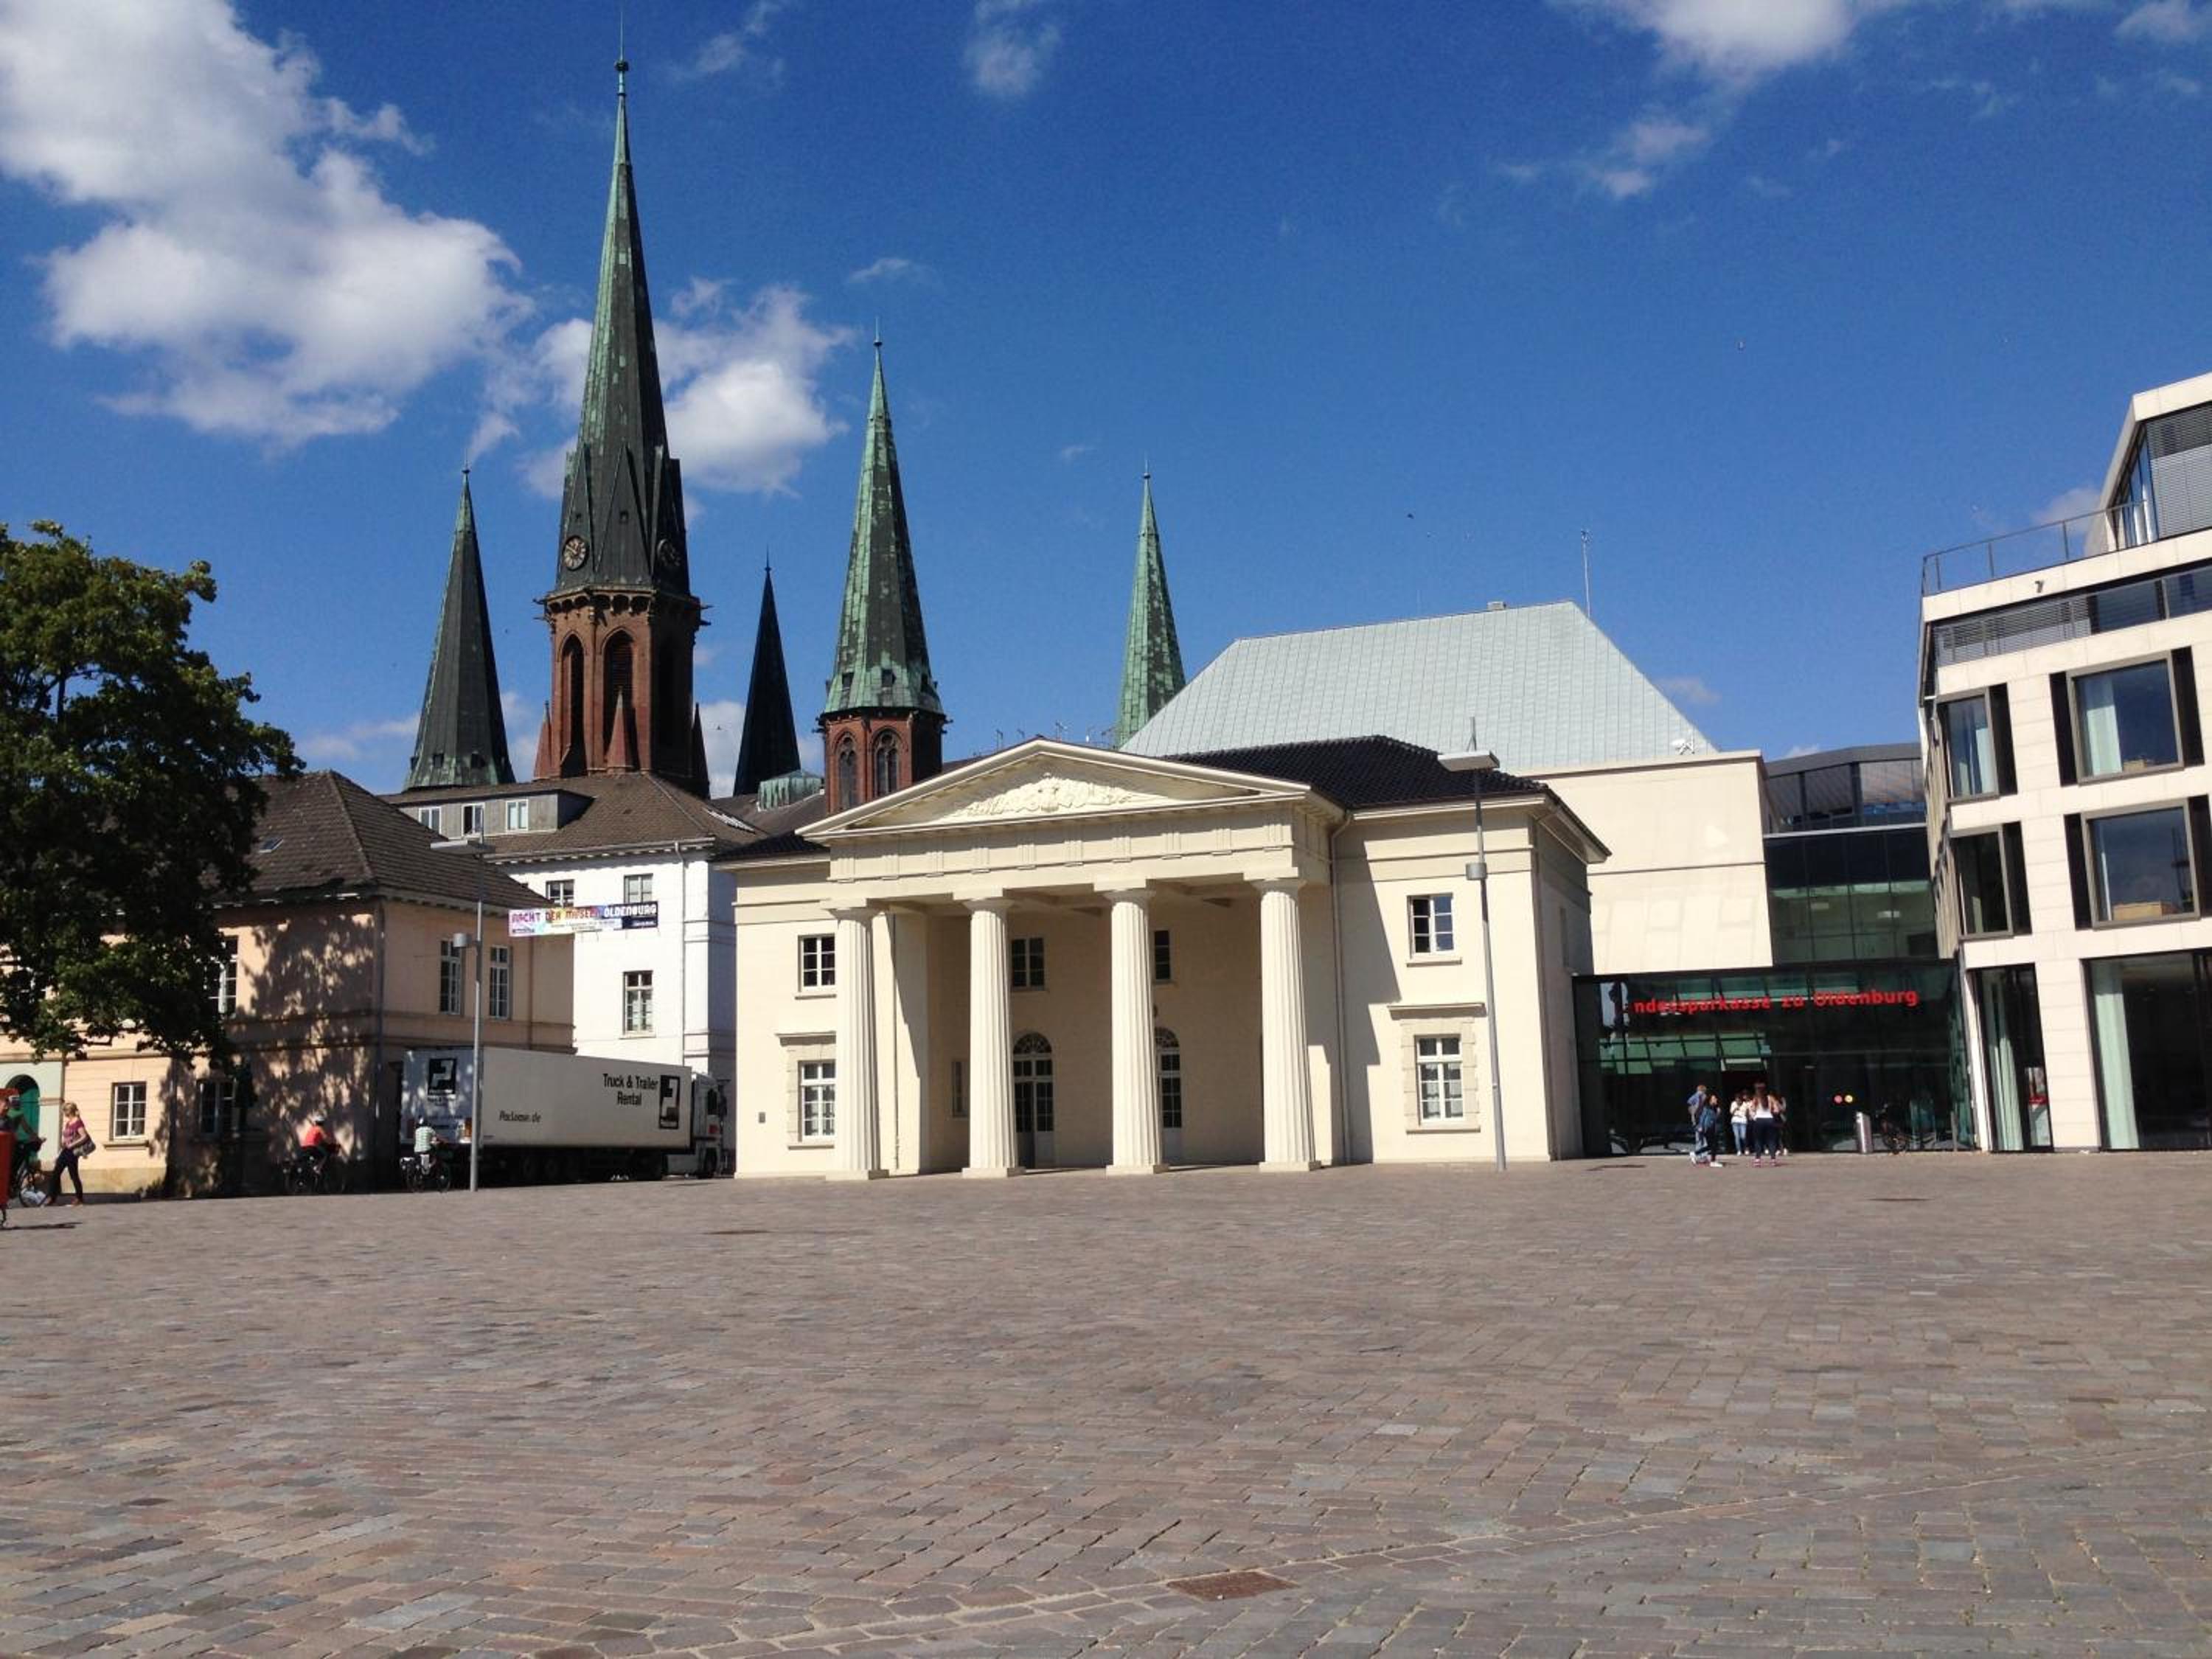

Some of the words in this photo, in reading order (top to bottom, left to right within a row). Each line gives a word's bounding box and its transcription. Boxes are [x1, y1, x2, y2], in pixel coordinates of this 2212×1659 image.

[1813, 989, 1919, 1007] Oldenburg
[602, 1073, 625, 1088] Truck
[627, 1074, 633, 1088] &
[636, 1076, 659, 1090] Trailer
[616, 1091, 641, 1105] Rental
